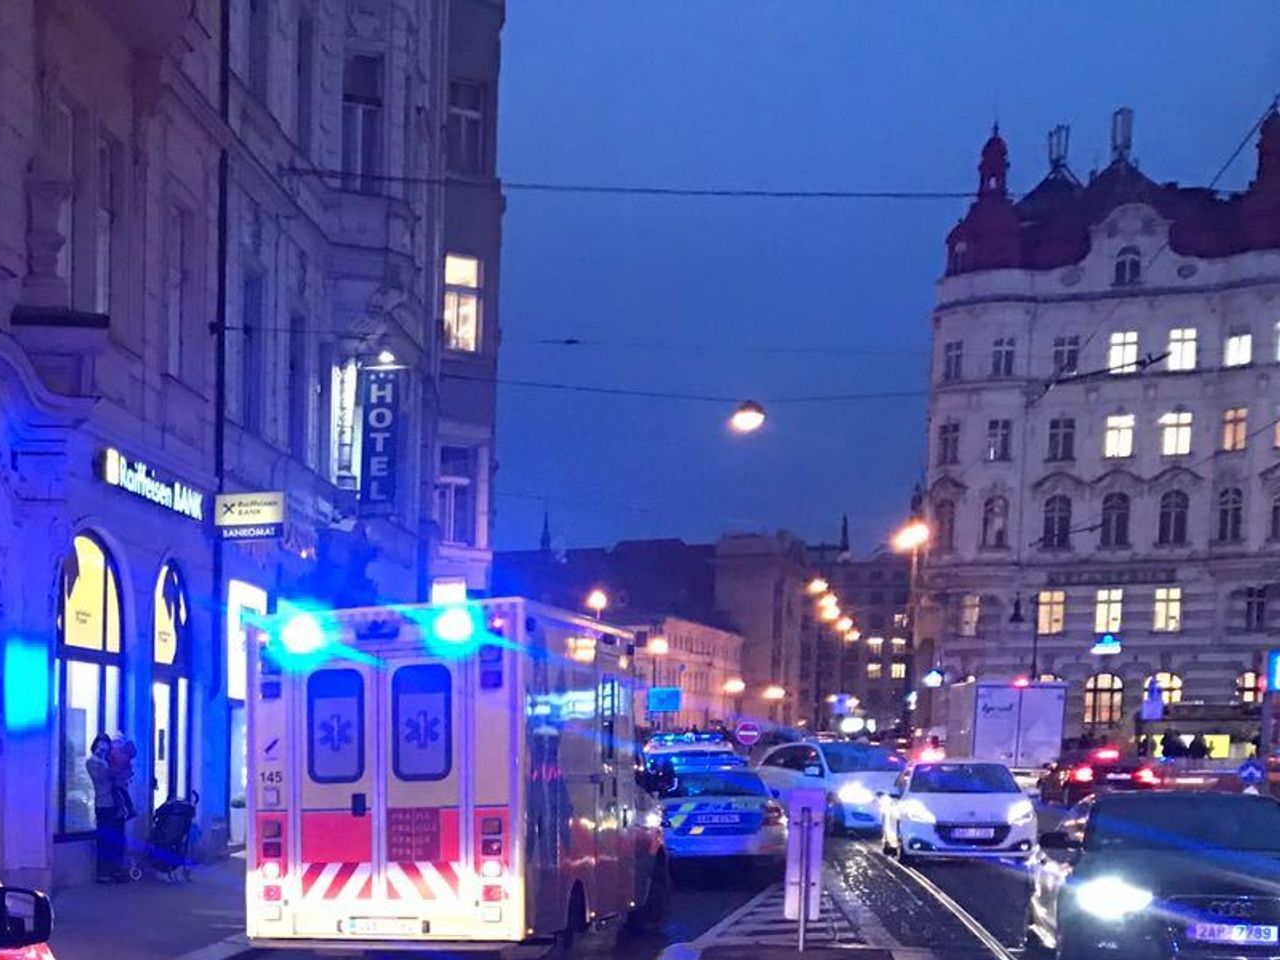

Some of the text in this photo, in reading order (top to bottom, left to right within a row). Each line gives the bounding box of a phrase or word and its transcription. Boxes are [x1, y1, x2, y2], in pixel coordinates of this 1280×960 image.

[368, 383, 393, 500] HOTEL
[222, 527, 276, 539] BANKOMAT
[260, 771, 282, 784] 145
